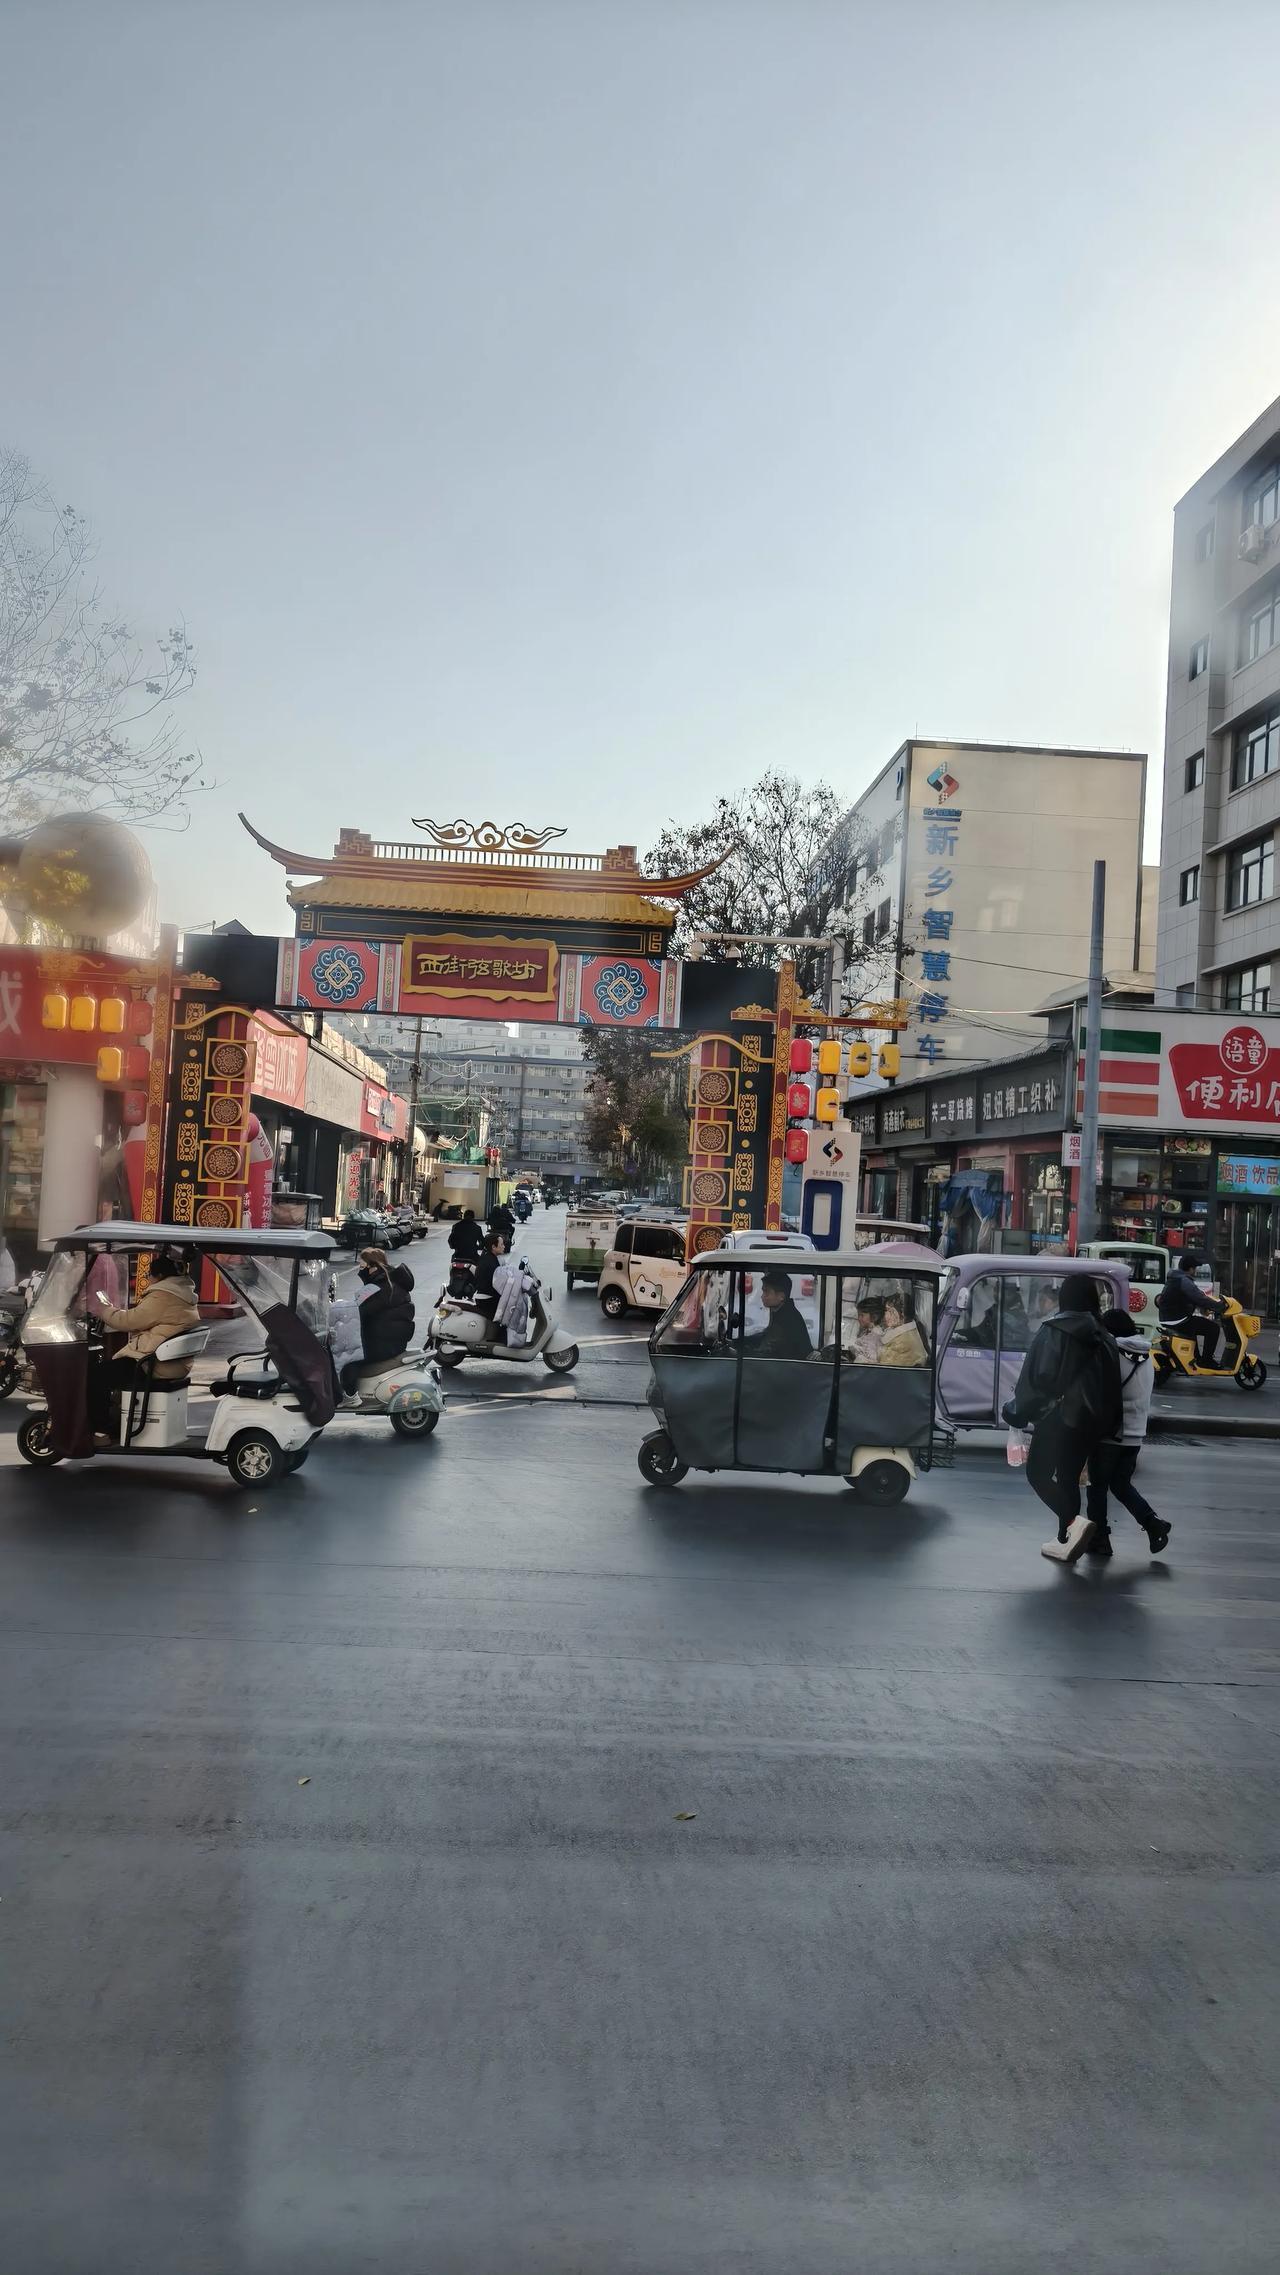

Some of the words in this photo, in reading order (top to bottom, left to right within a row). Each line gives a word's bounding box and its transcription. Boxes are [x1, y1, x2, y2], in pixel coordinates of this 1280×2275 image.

[917, 824, 959, 1066] 新乡智慧停车
[416, 953, 543, 980] 西街弦歌坊
[931, 1096, 974, 1123] 关二哥烧烤
[982, 1078, 1057, 1121] 妞妞精工织补
[1069, 1135, 1081, 1160] 烟酒
[1221, 1163, 1249, 1184] 烟酒
[1252, 1164, 1279, 1185] 饮品
